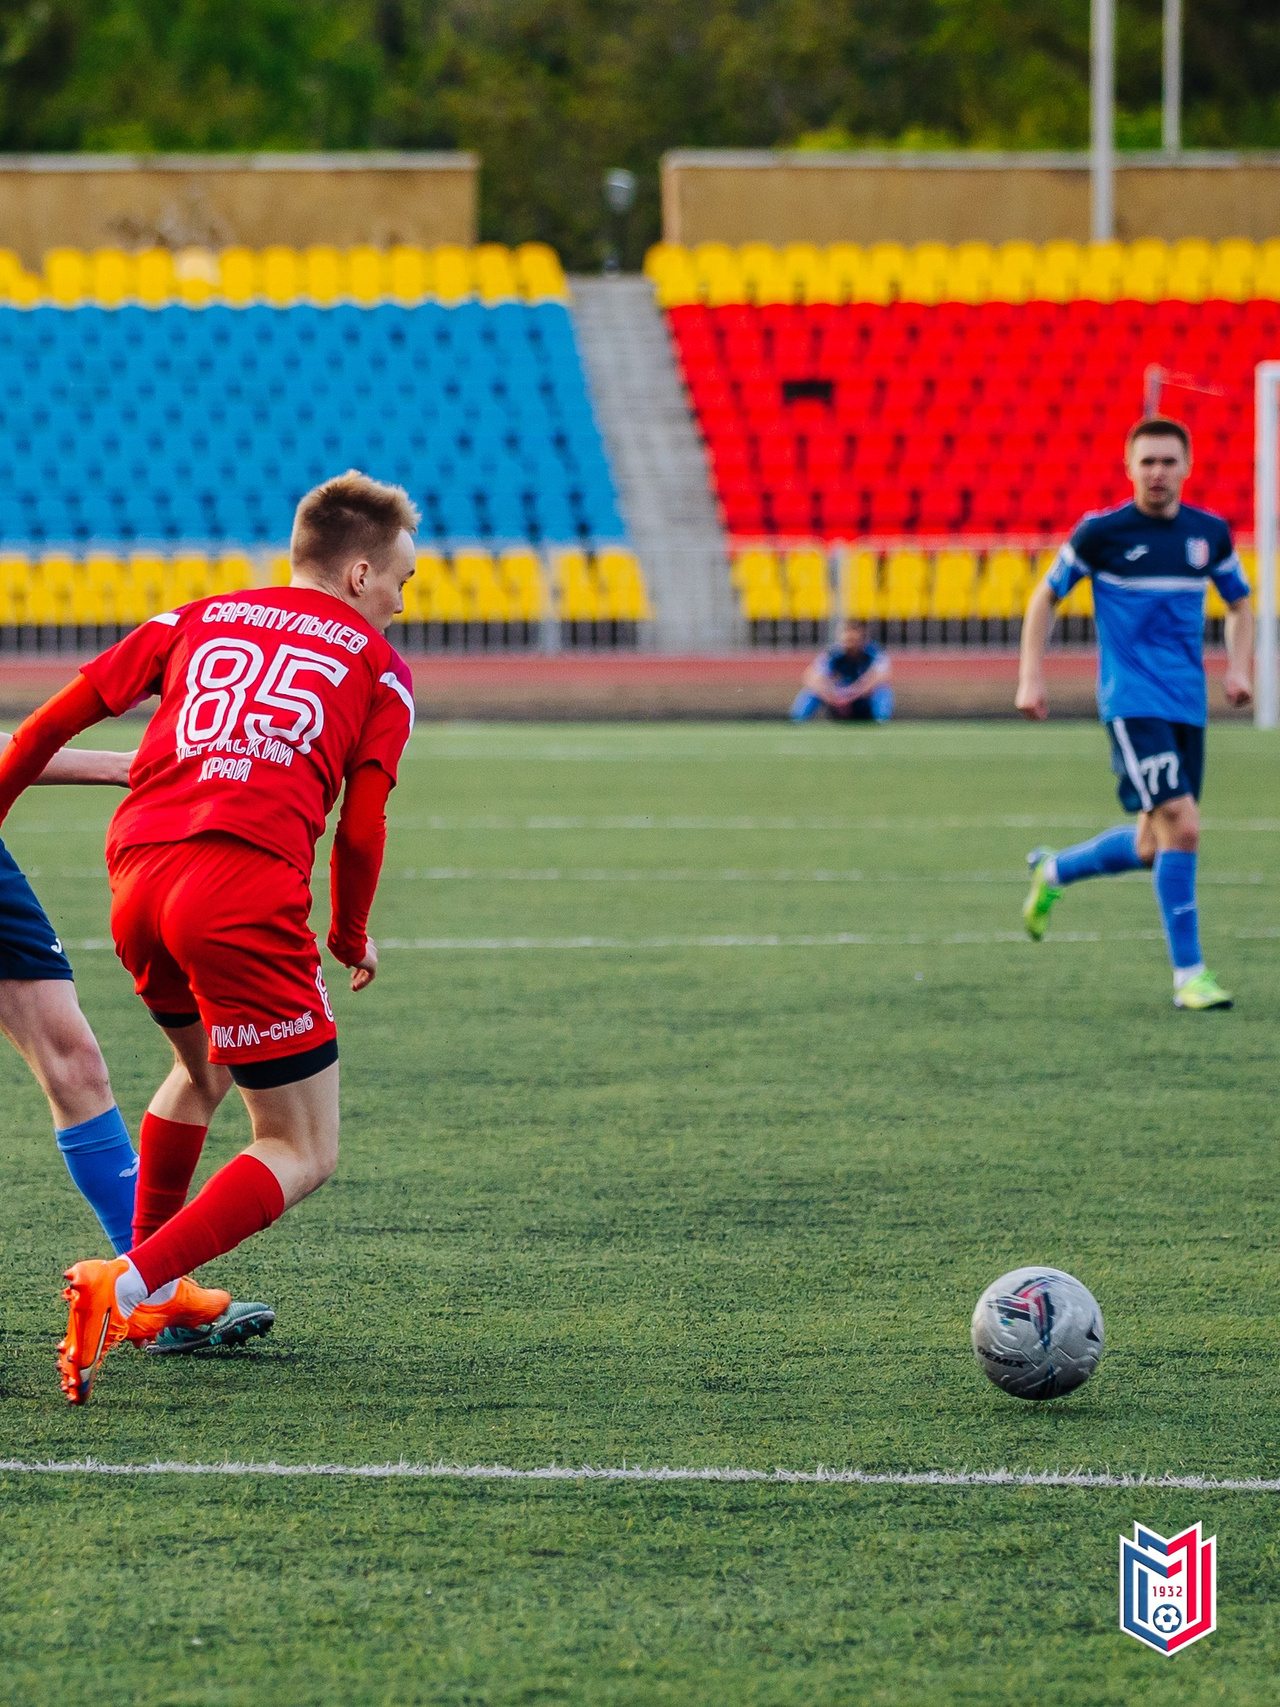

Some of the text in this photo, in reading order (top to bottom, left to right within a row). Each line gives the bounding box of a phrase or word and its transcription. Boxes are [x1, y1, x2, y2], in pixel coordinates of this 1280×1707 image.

[201, 601, 370, 655] САРАПУЛЬЦЕВ
[175, 637, 350, 755] 85
[198, 756, 253, 783] КРАЙ
[1138, 751, 1180, 795] 77
[977, 1345, 1029, 1369] DEMIX
